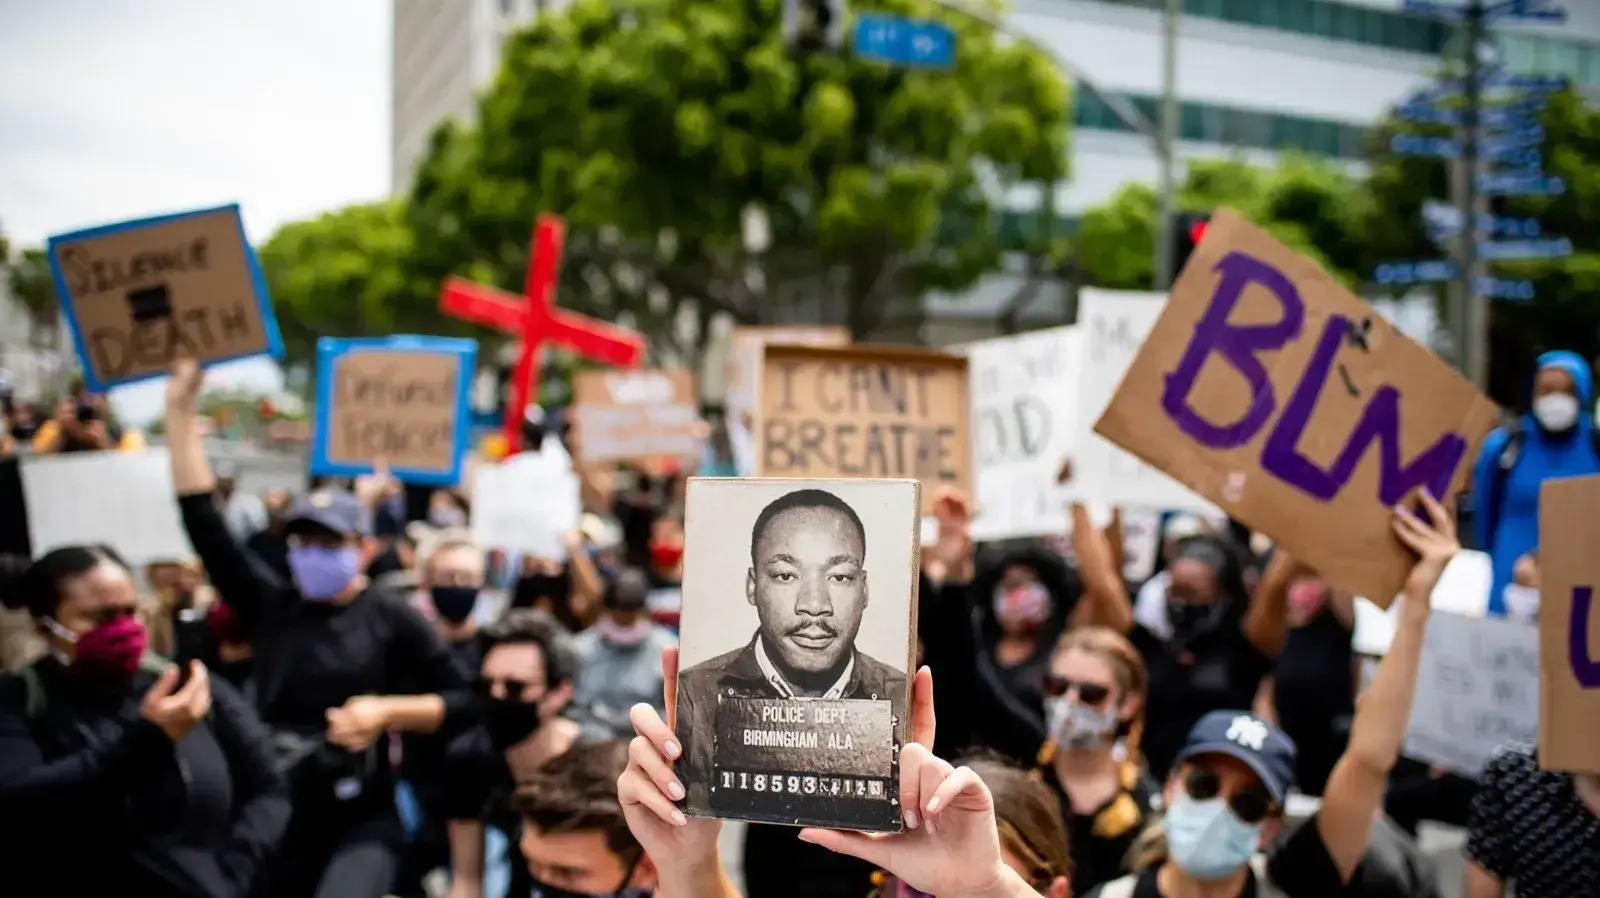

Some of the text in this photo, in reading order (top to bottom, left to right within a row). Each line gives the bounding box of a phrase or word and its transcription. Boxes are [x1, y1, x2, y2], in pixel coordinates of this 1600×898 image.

[89, 302, 249, 380] DEATH
[779, 362, 802, 409] I
[1161, 250, 1467, 526] BLM
[764, 418, 957, 480] BREATHE
[763, 706, 846, 724] POLICE DEPT
[744, 729, 853, 749] BIRMINGHAM ALA
[722, 772, 817, 794] 118593
